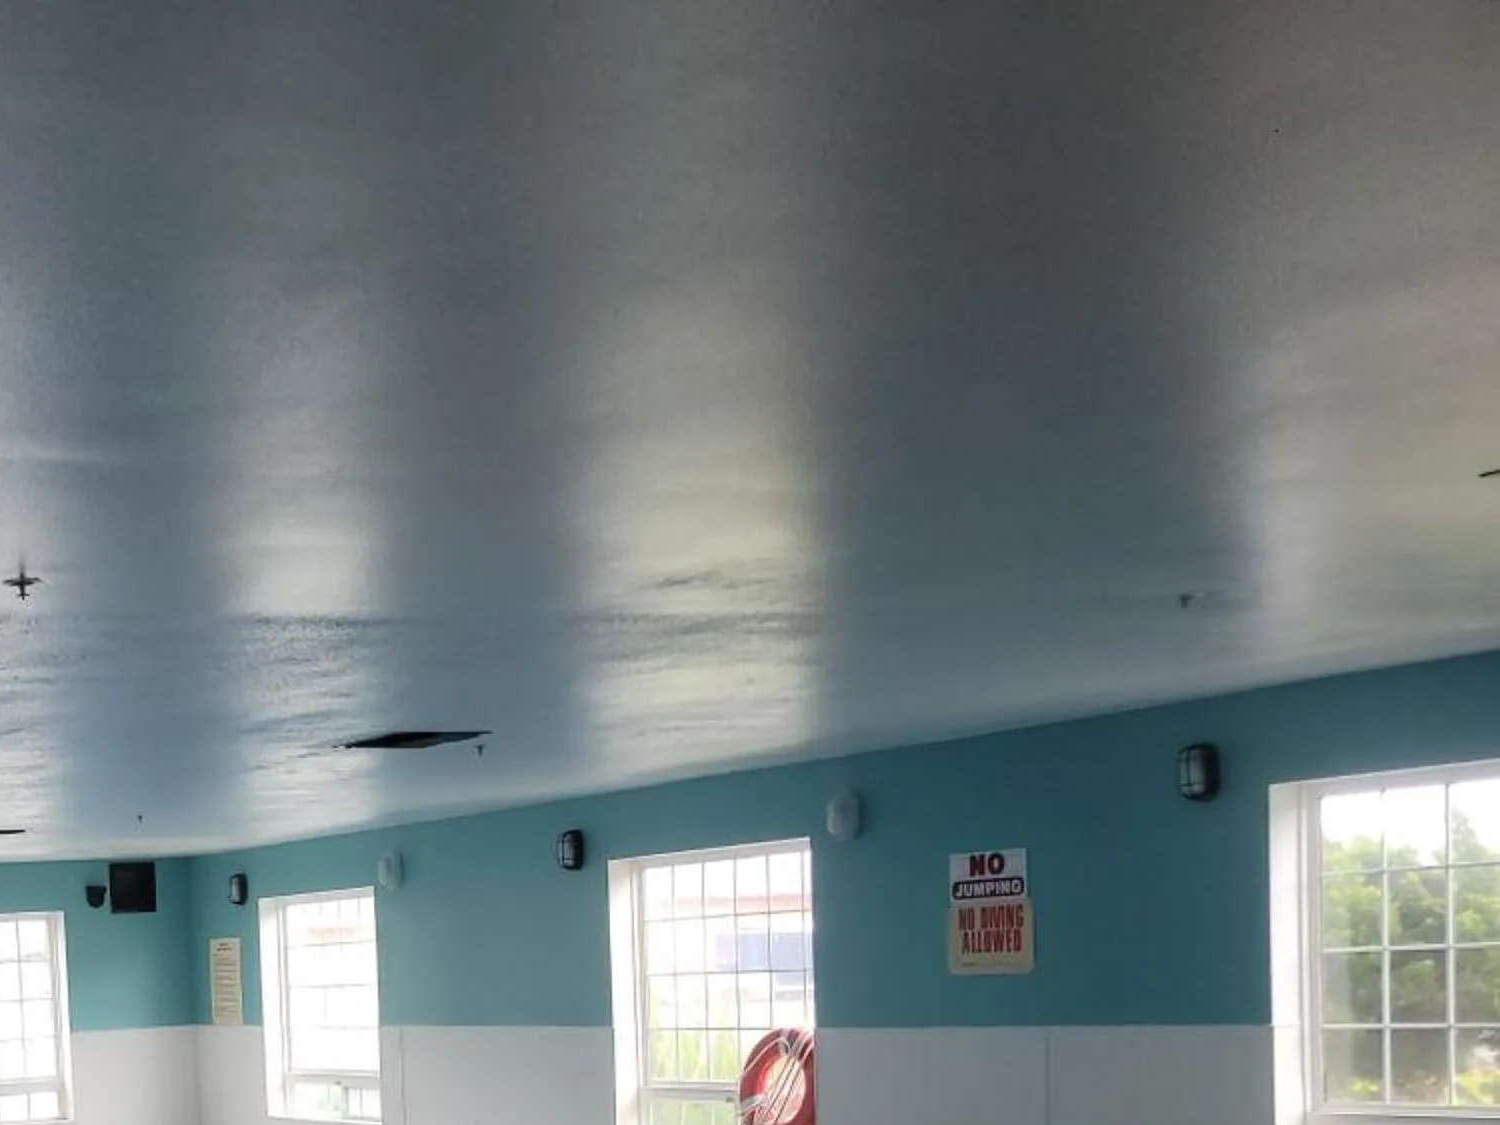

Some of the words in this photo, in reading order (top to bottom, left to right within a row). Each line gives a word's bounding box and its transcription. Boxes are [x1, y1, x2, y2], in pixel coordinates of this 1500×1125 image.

[970, 852, 1004, 877] NO
[955, 880, 1021, 897] JUMPING
[958, 907, 975, 930] NO
[981, 904, 1024, 930] DIVING
[962, 929, 1022, 955] ALLOWED
